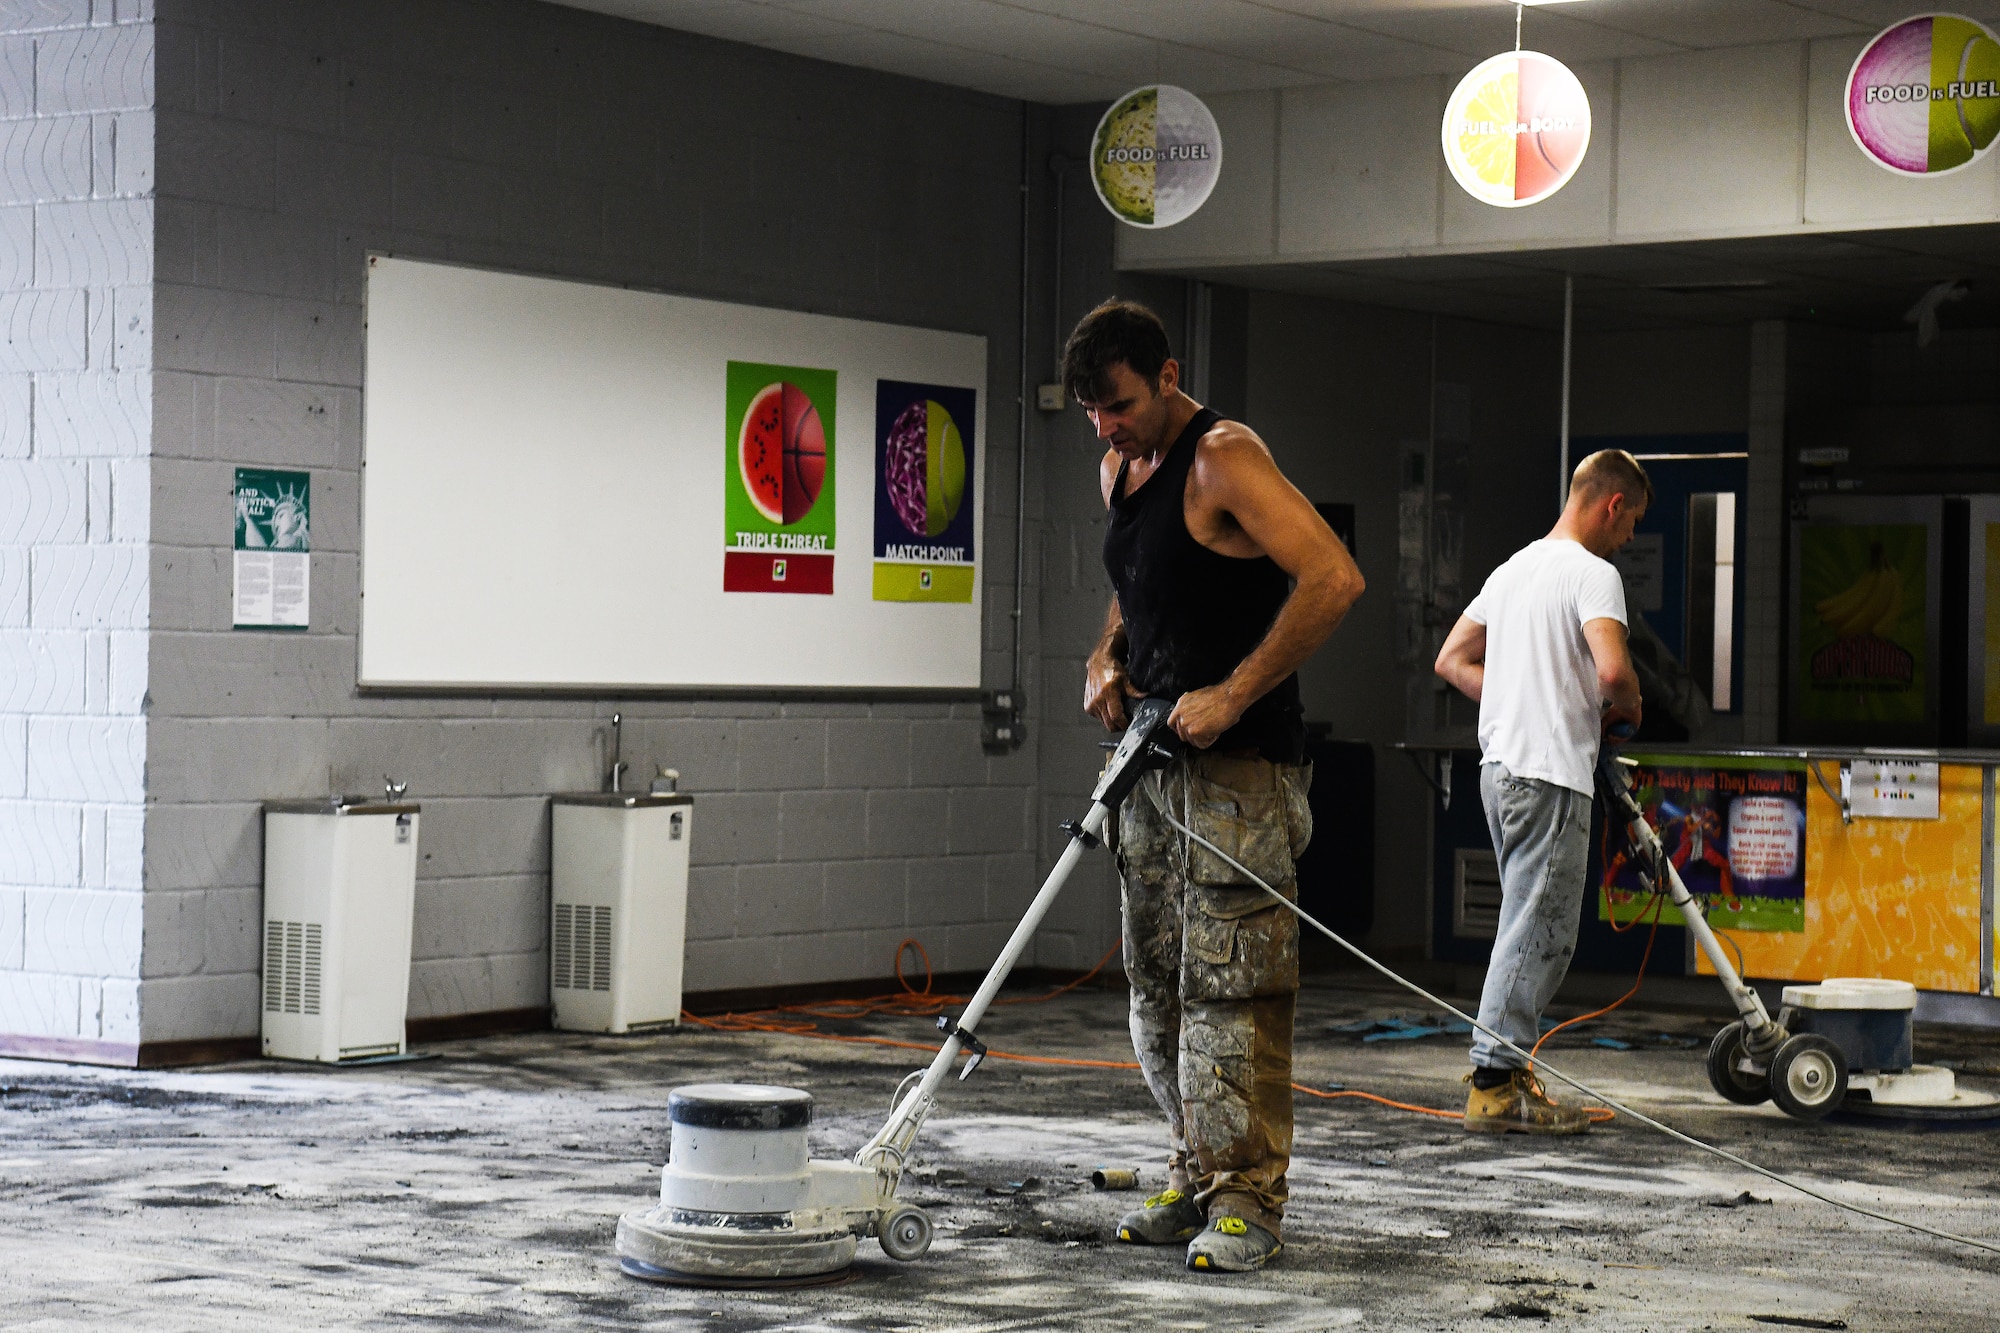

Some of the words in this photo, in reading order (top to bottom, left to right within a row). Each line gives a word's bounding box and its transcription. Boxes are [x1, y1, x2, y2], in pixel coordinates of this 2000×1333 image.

[1865, 84, 1929, 104] FOOD
[1948, 81, 2000, 100] FUEL
[1459, 121, 1497, 137] FUEL
[1530, 116, 1576, 133] BODY
[1107, 147, 1154, 164] FOOD
[1169, 144, 1209, 160] FUEL
[239, 487, 258, 498] AND
[249, 506, 265, 516] ALL
[735, 531, 777, 549] TRIPLE
[780, 533, 828, 550] THREAT
[885, 543, 928, 560] MATCH
[930, 545, 965, 561] POINT
[1693, 772, 1715, 790] and
[1718, 772, 1745, 795] They
[1748, 772, 1781, 792] Know
